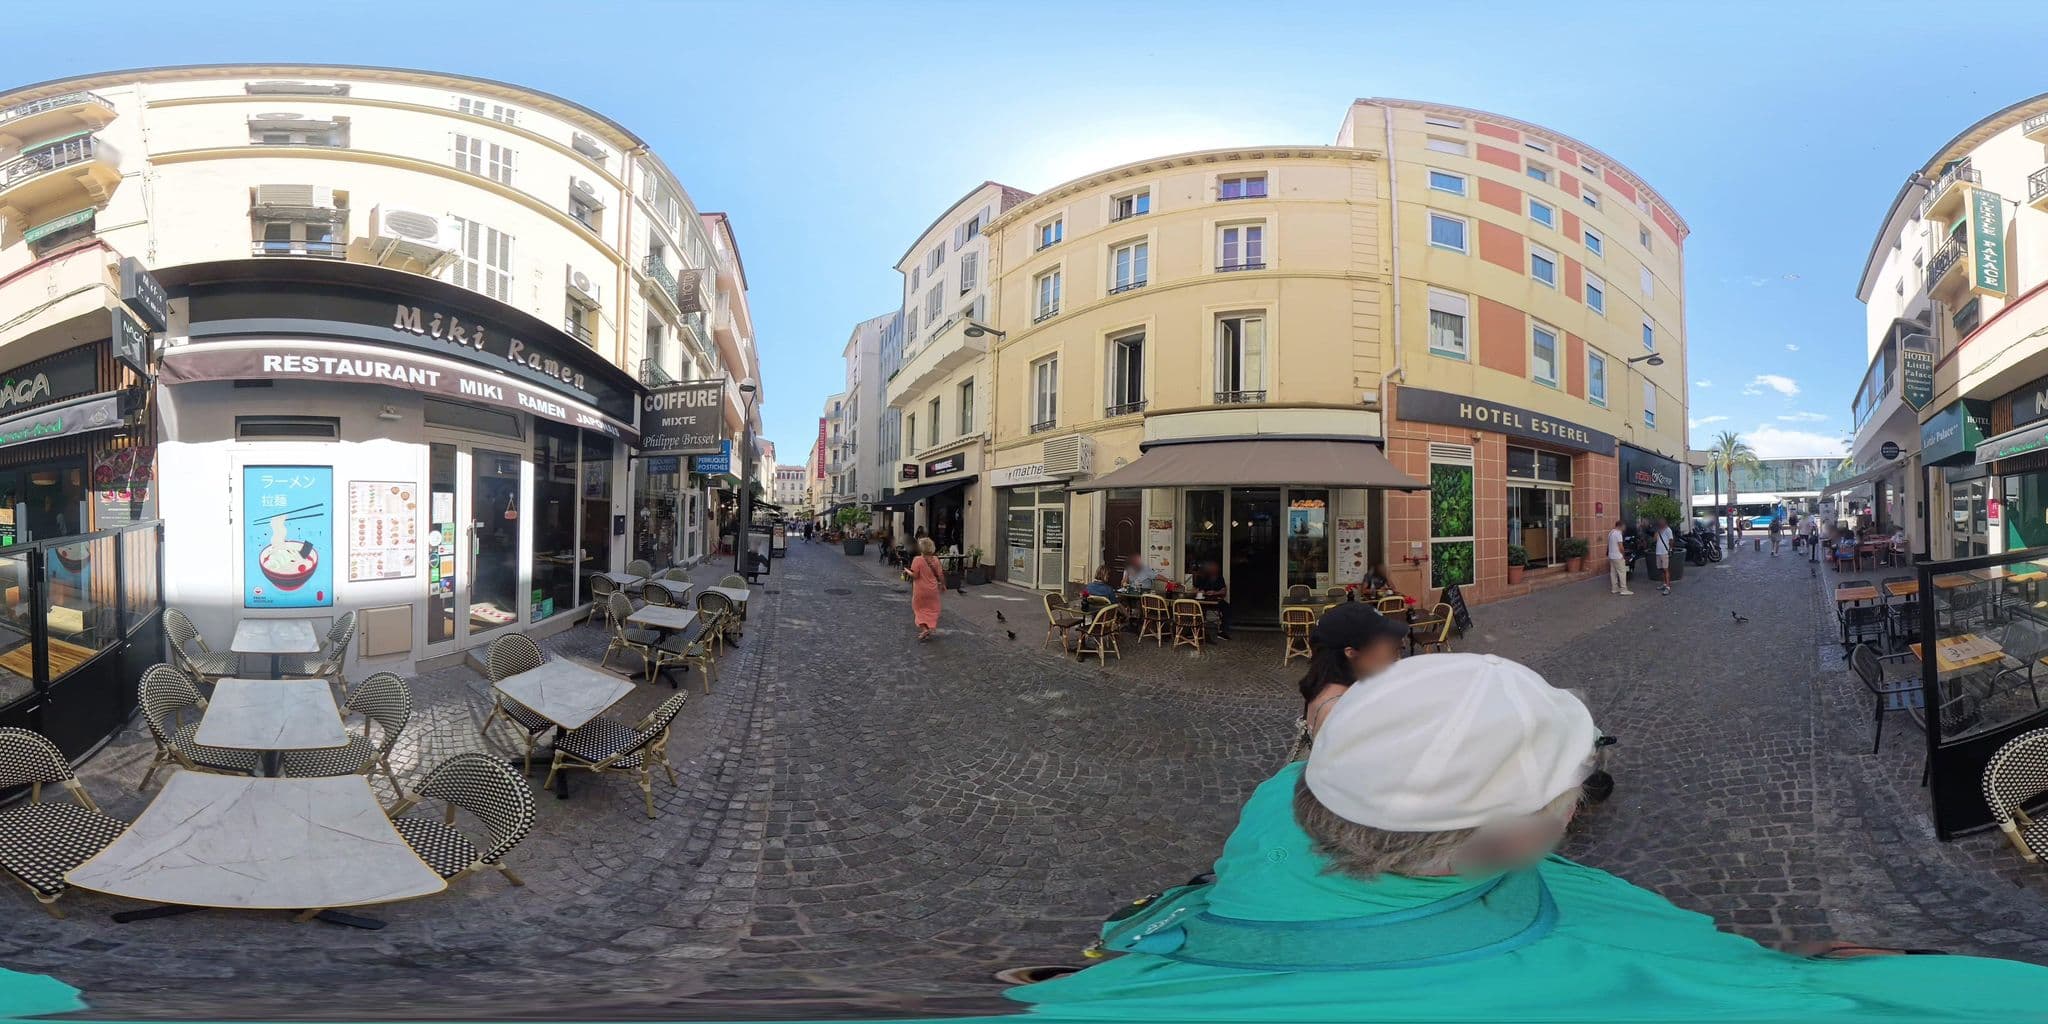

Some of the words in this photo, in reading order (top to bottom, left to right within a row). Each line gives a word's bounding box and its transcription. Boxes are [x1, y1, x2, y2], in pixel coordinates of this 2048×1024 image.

[393, 299, 485, 350] Miki
[507, 337, 585, 391] Ramen
[1904, 351, 1931, 362] HOTEL
[1906, 360, 1931, 370] Little
[1905, 370, 1932, 379] Palace
[263, 355, 440, 387] RESTAURANT
[459, 378, 503, 401] MIKI
[517, 392, 566, 419] RAMEN
[644, 389, 718, 412] COIFFURE
[662, 416, 697, 427] MIXTE
[1459, 403, 1522, 428] HOTEL
[1531, 418, 1590, 444] ESTEREL
[1967, 416, 1989, 425] HOTEL
[643, 433, 680, 450] Philippe
[681, 432, 714, 446] Brisset
[261, 475, 316, 489] ラーメン
